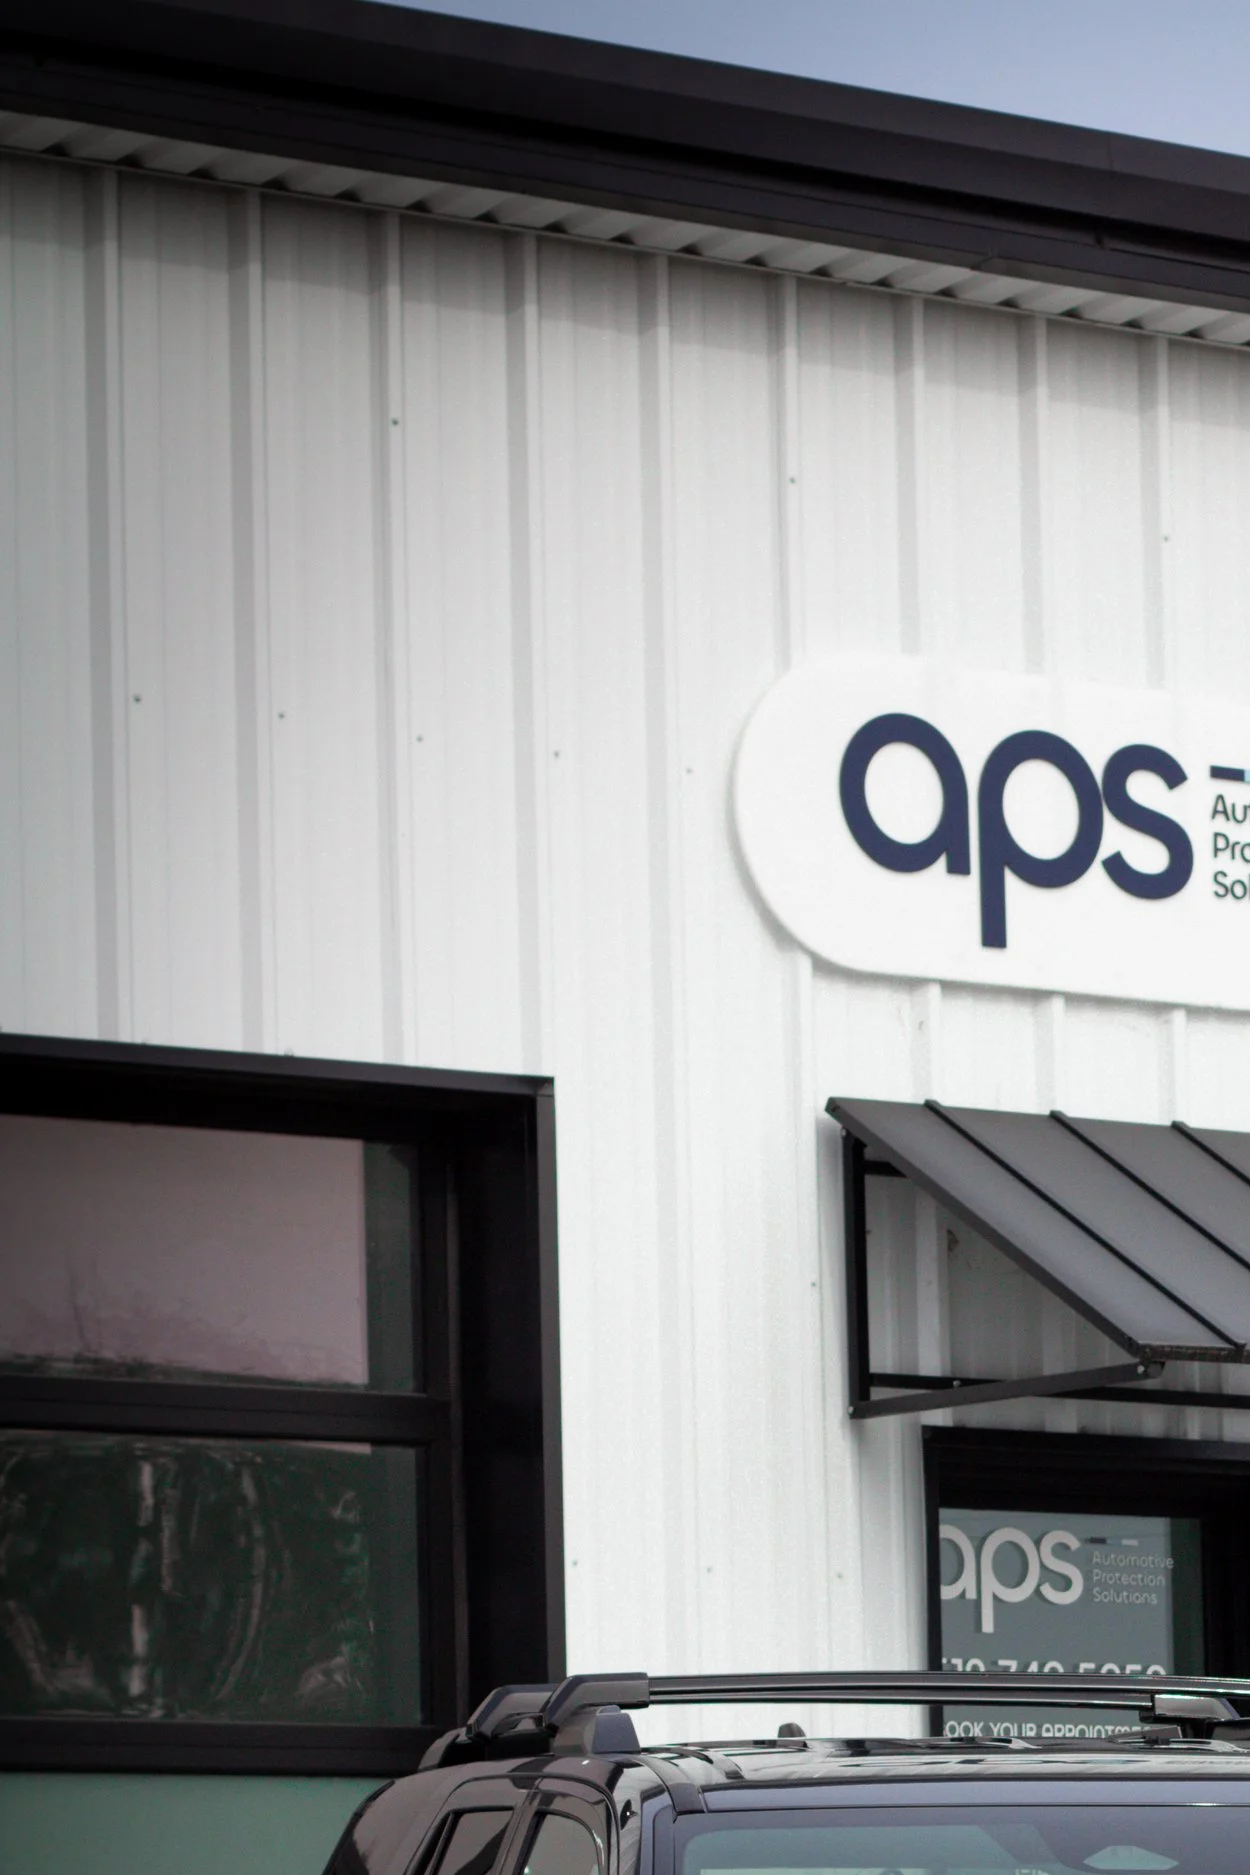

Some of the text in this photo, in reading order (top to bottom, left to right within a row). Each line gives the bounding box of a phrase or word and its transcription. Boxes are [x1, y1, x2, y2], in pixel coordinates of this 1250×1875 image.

[838, 711, 1195, 949] aps
[1092, 1551, 1174, 1569] Automotive
[1093, 1569, 1166, 1586] Protection
[1093, 1587, 1158, 1604] Solutions
